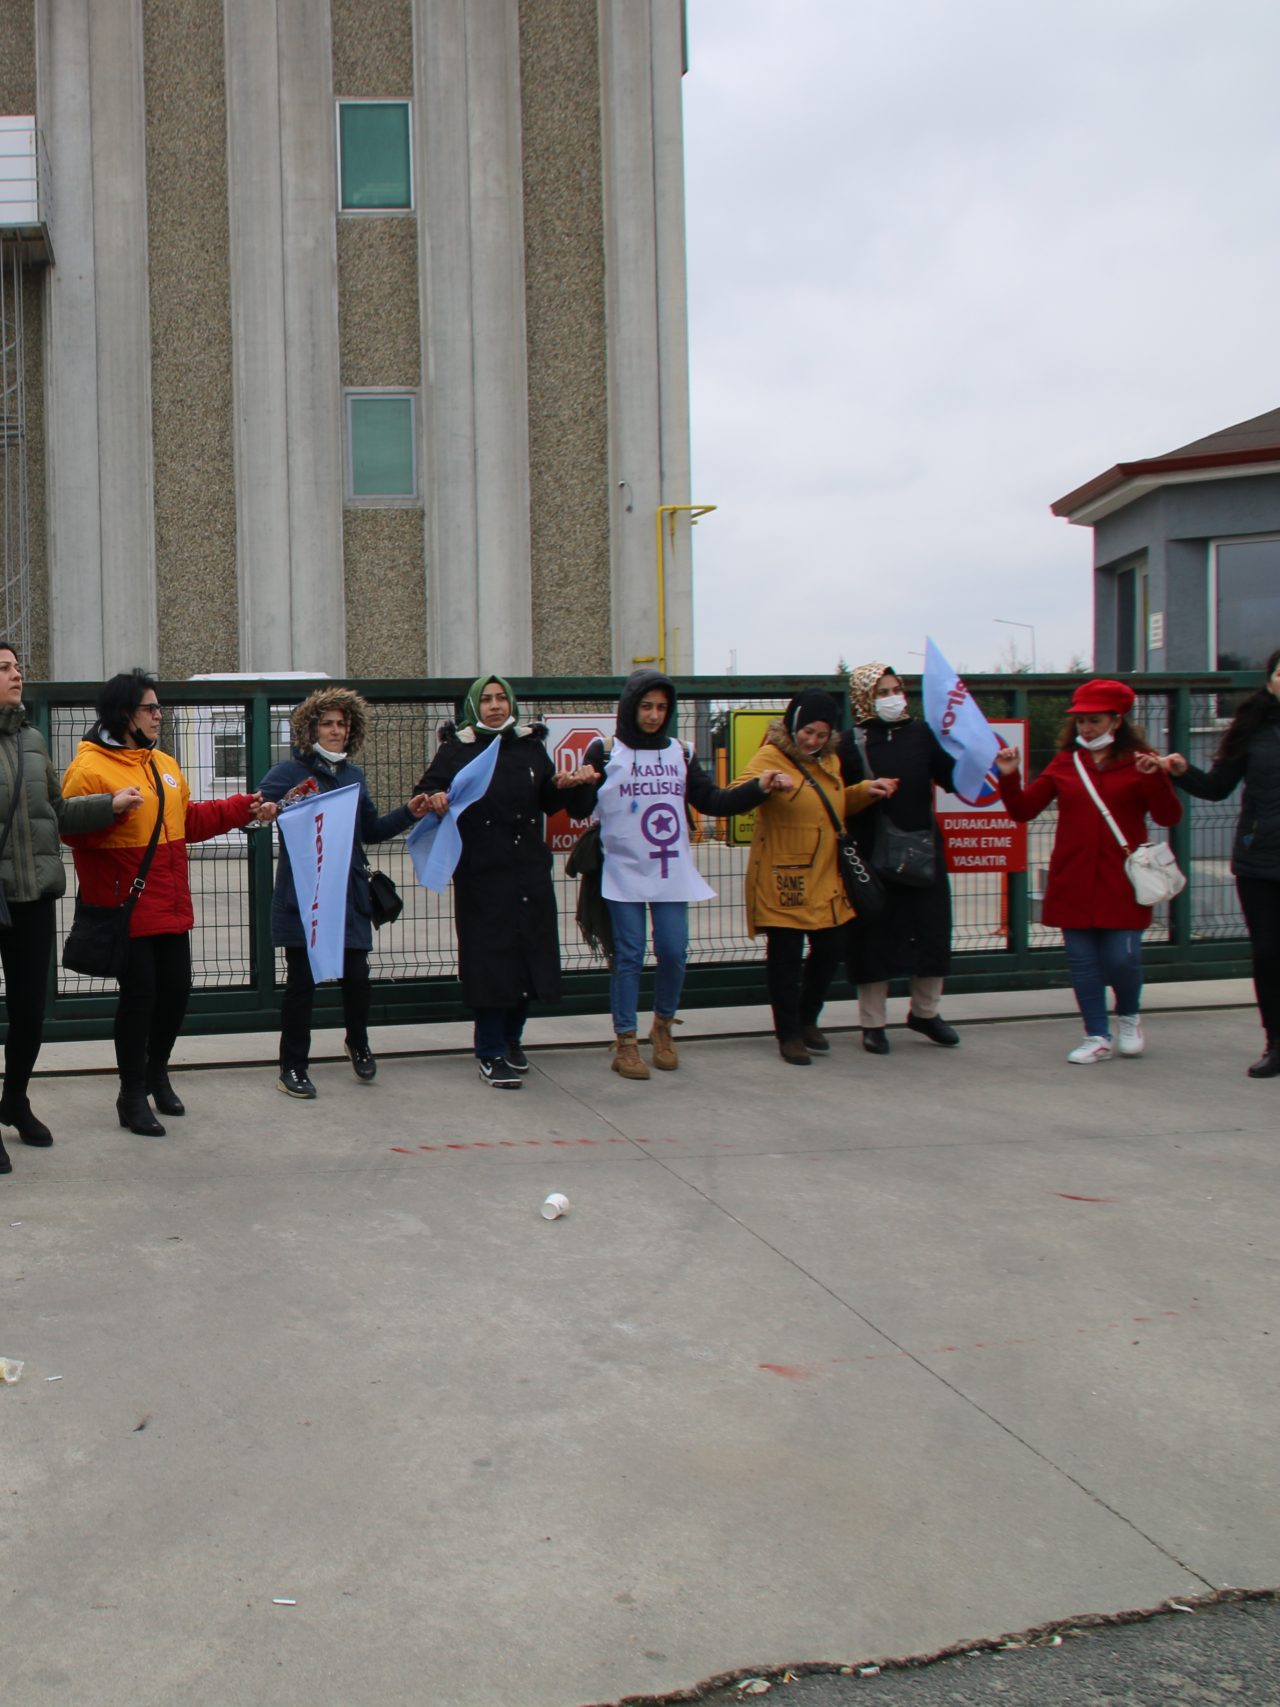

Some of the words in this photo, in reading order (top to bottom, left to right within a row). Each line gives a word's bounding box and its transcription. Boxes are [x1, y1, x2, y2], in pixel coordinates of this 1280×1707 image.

[630, 763, 679, 778] KADIN
[944, 818, 1017, 830] DURAKLAMA
[948, 837, 978, 848] PARK
[980, 836, 1012, 848] ETME
[952, 855, 1007, 867] YASAKTIR
[776, 875, 805, 891] SAME
